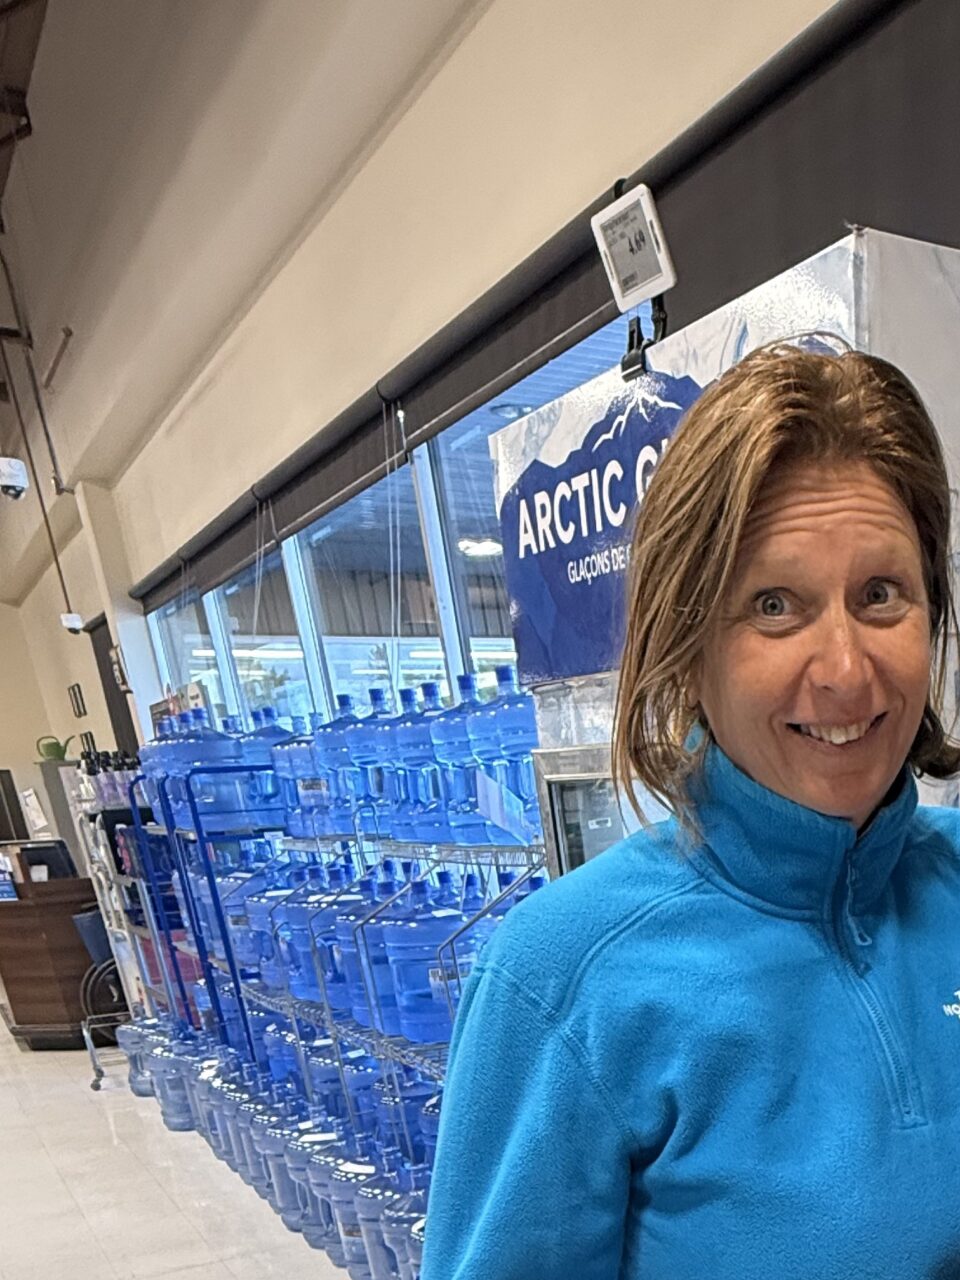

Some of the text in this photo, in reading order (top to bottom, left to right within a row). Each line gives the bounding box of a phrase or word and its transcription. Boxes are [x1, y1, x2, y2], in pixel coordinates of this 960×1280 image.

[518, 438, 669, 559] ARCTIC G
[567, 546, 626, 585] GLAÇONS DE
